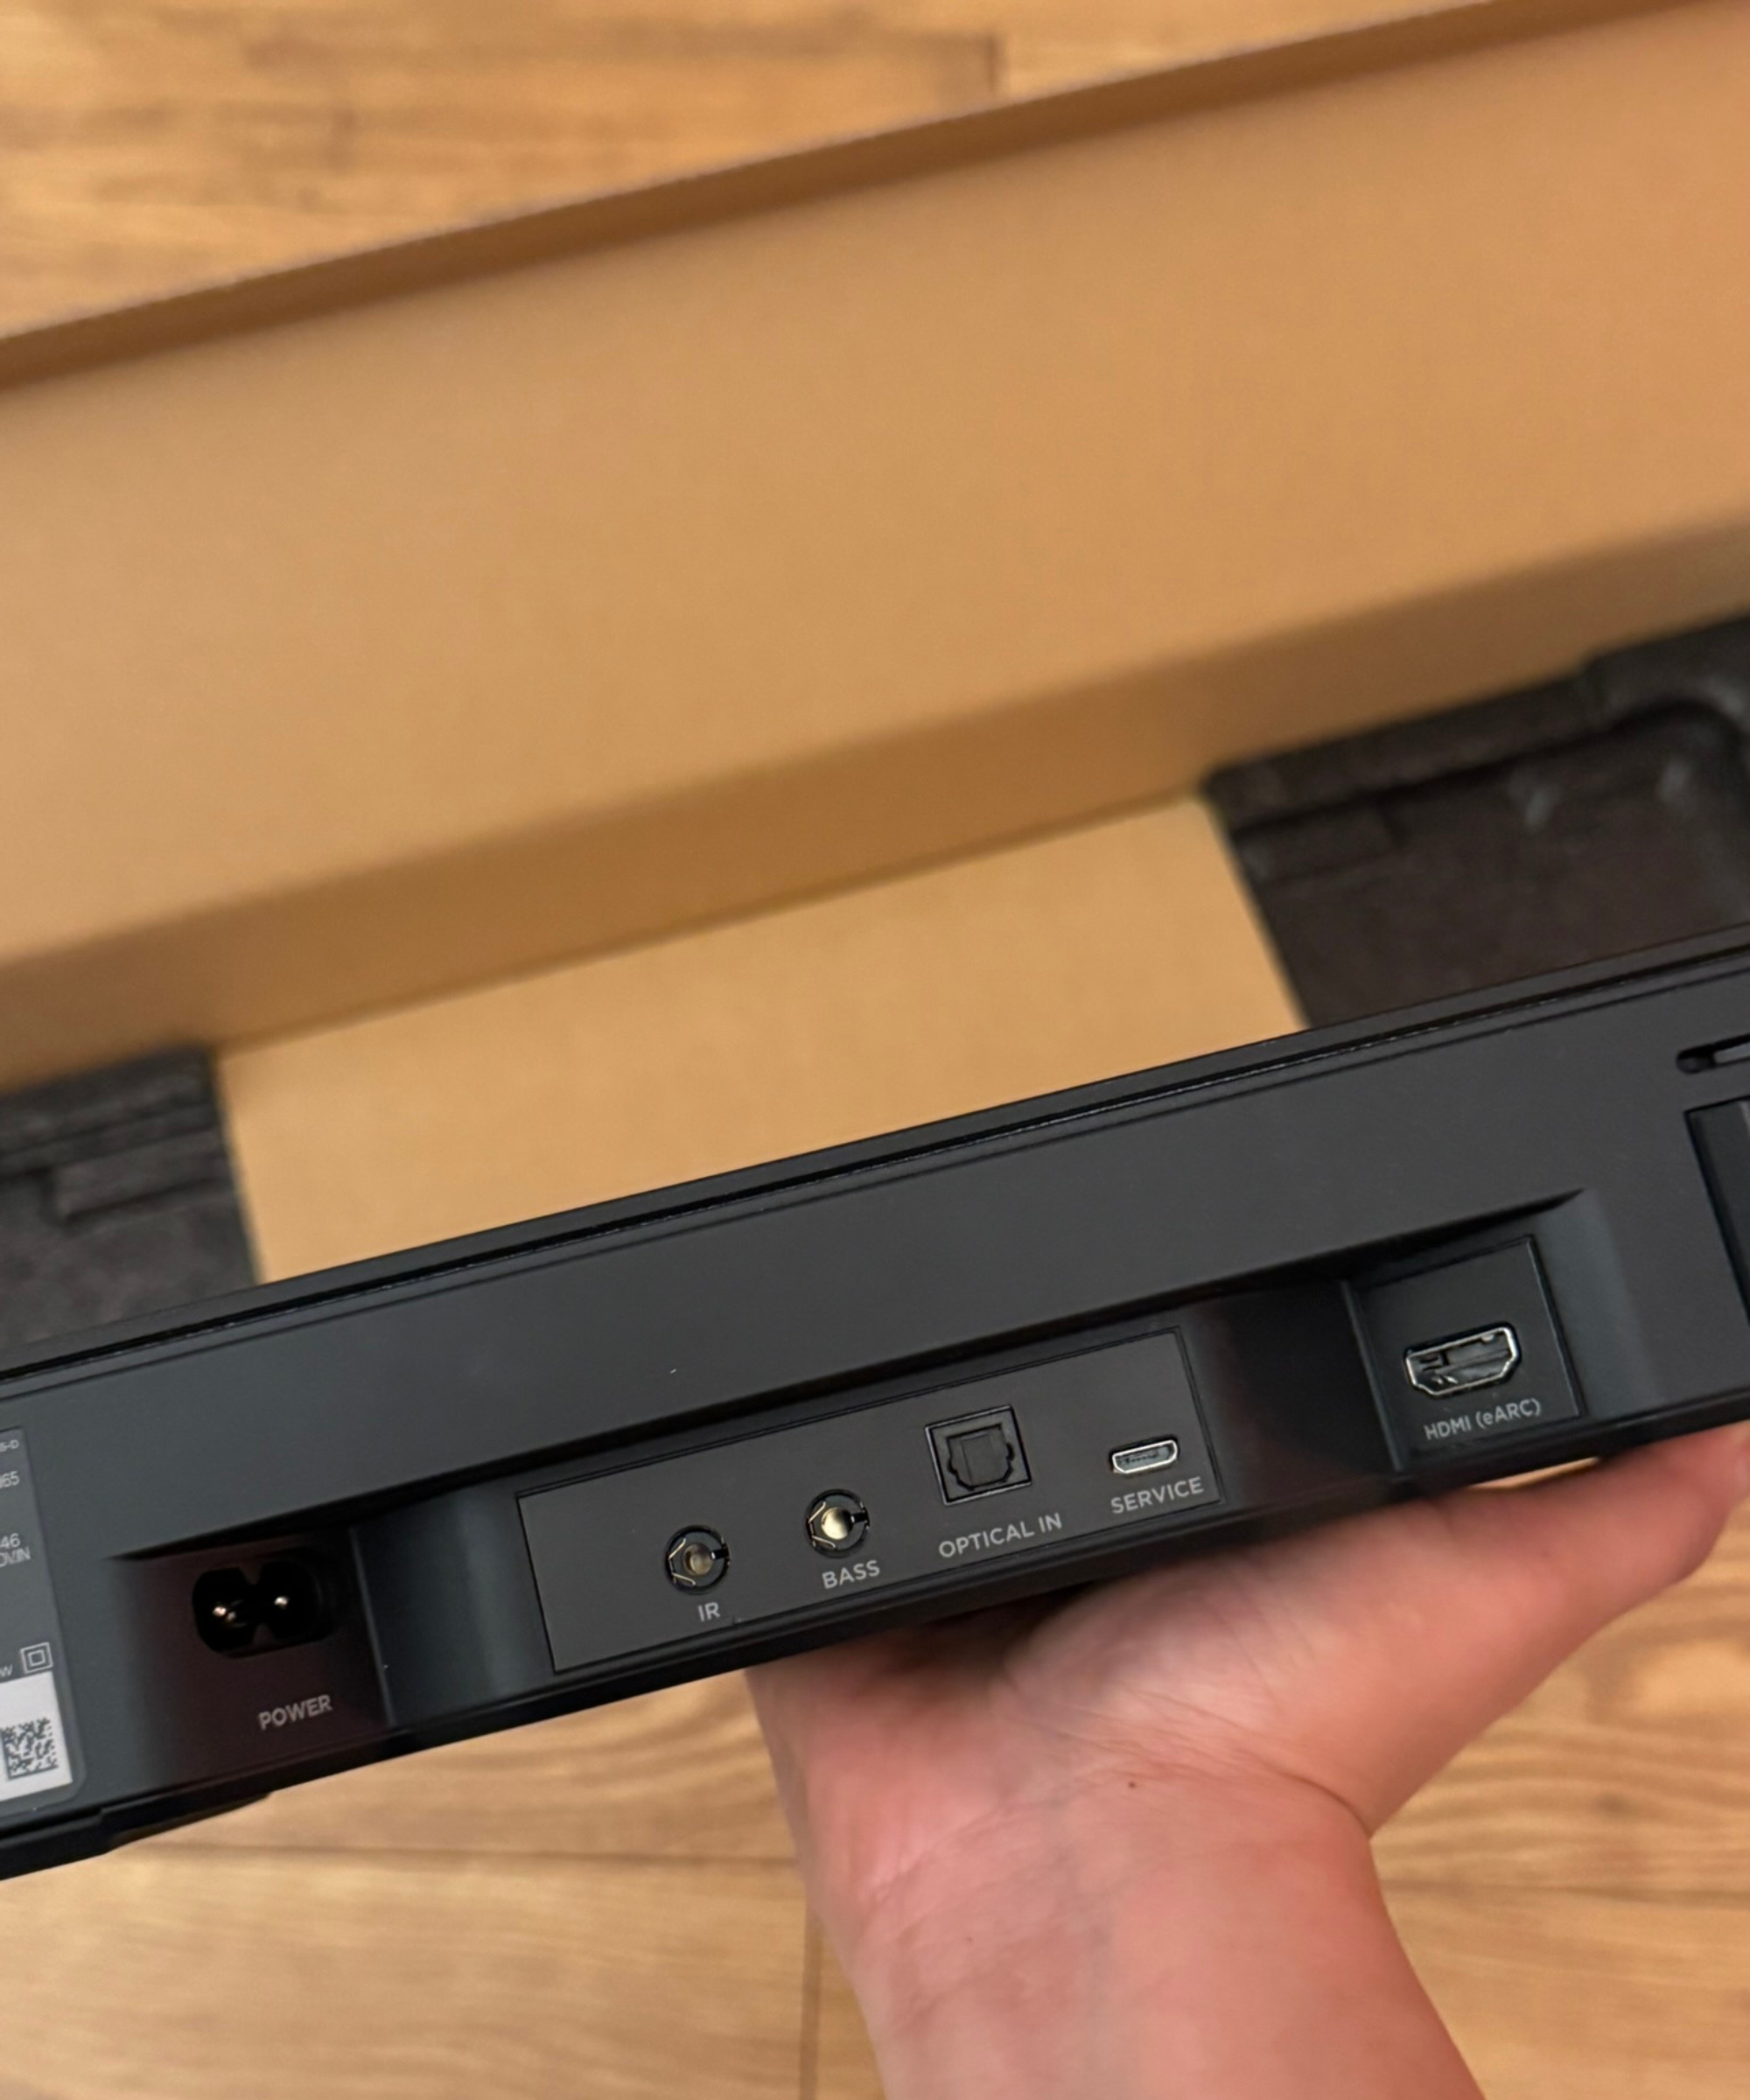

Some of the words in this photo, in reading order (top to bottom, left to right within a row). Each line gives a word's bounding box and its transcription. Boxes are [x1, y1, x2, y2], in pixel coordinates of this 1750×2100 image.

[1424, 1415, 1472, 1440] HDMI
[1474, 1397, 1542, 1430] (eARC)
[1110, 1476, 1205, 1515] SERVICE
[938, 1522, 1035, 1558] OPTICAL
[1038, 1512, 1063, 1532] IN
[822, 1559, 880, 1590] BASS
[697, 1601, 721, 1622] IR
[258, 1694, 332, 1731] POWER
